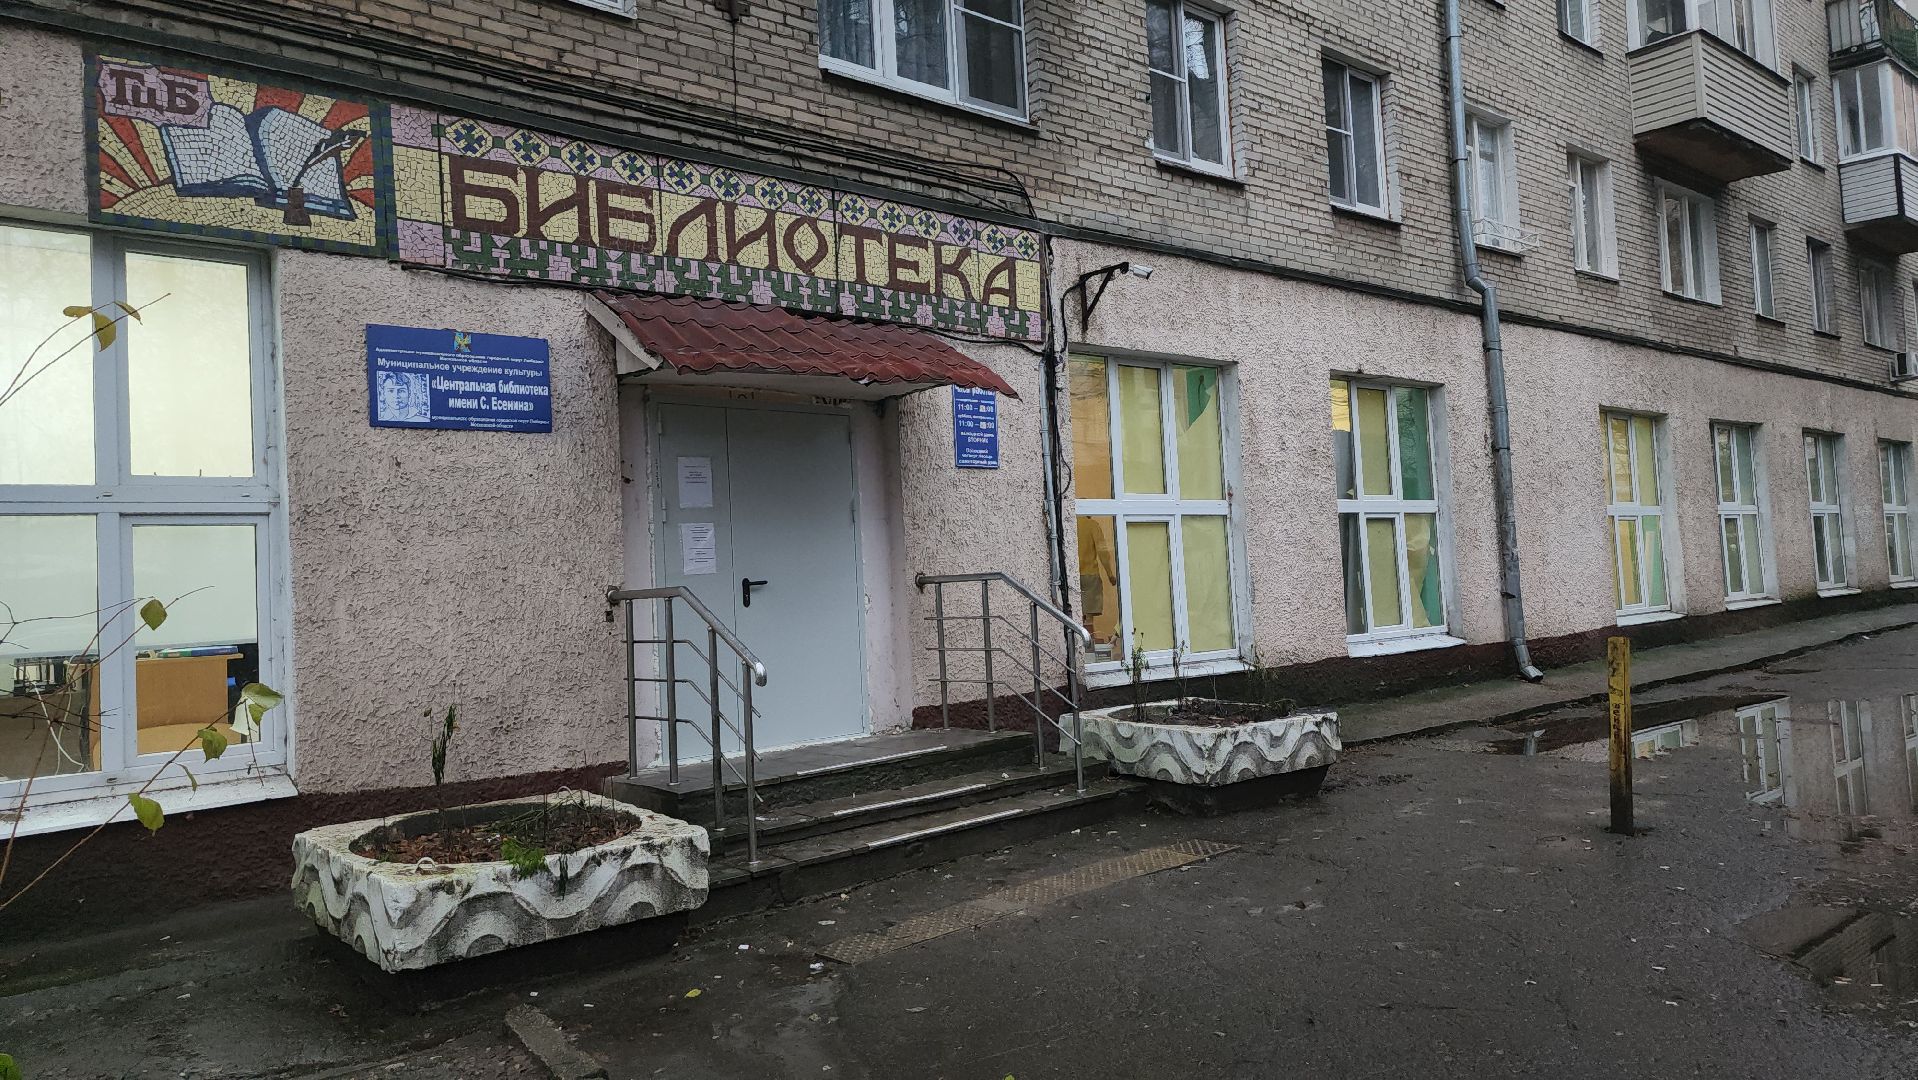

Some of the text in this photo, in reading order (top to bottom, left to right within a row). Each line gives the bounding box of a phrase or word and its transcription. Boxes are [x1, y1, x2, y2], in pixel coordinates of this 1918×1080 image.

[448, 154, 1018, 309] БИБЛИОТЕКА
[377, 357, 450, 370] Муниципальное
[452, 364, 503, 374] учреждение
[504, 368, 543, 378] культуры
[431, 375, 549, 396] «Центральная библиотека
[448, 396, 534, 411] имени С. Есенина»
